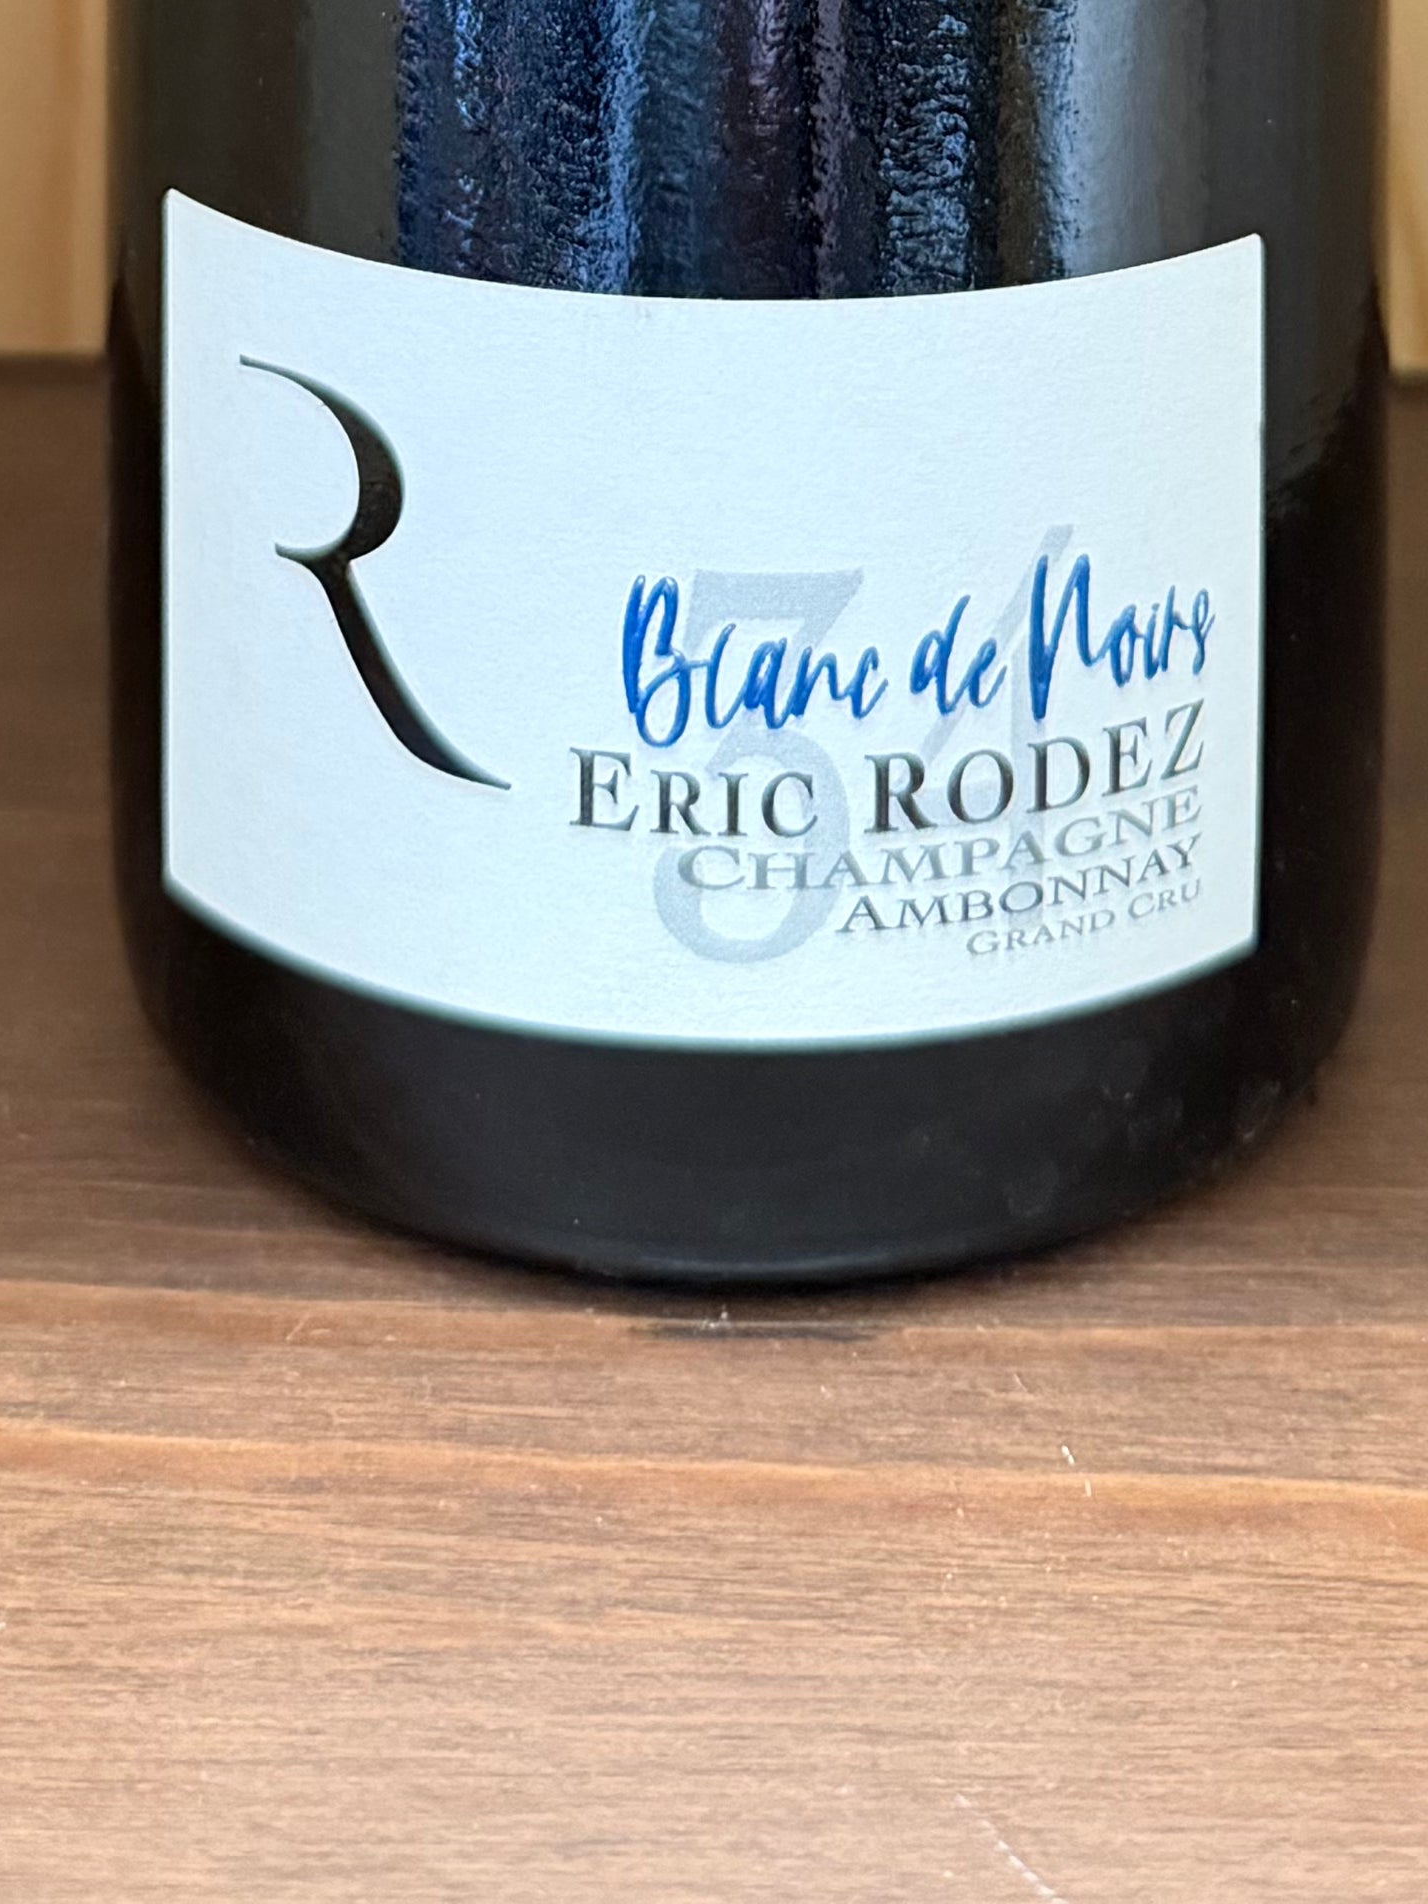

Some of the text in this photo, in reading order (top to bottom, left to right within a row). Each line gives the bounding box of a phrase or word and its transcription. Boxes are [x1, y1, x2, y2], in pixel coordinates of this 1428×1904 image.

[240, 354, 511, 790] R
[622, 553, 1216, 748] Blanc de Noirs
[569, 698, 1207, 838] ERIC RODEZ
[678, 785, 1203, 891] CHAMPAGNE
[835, 832, 1202, 934] AMBONNAY
[966, 878, 1202, 956] GRAND CRU
